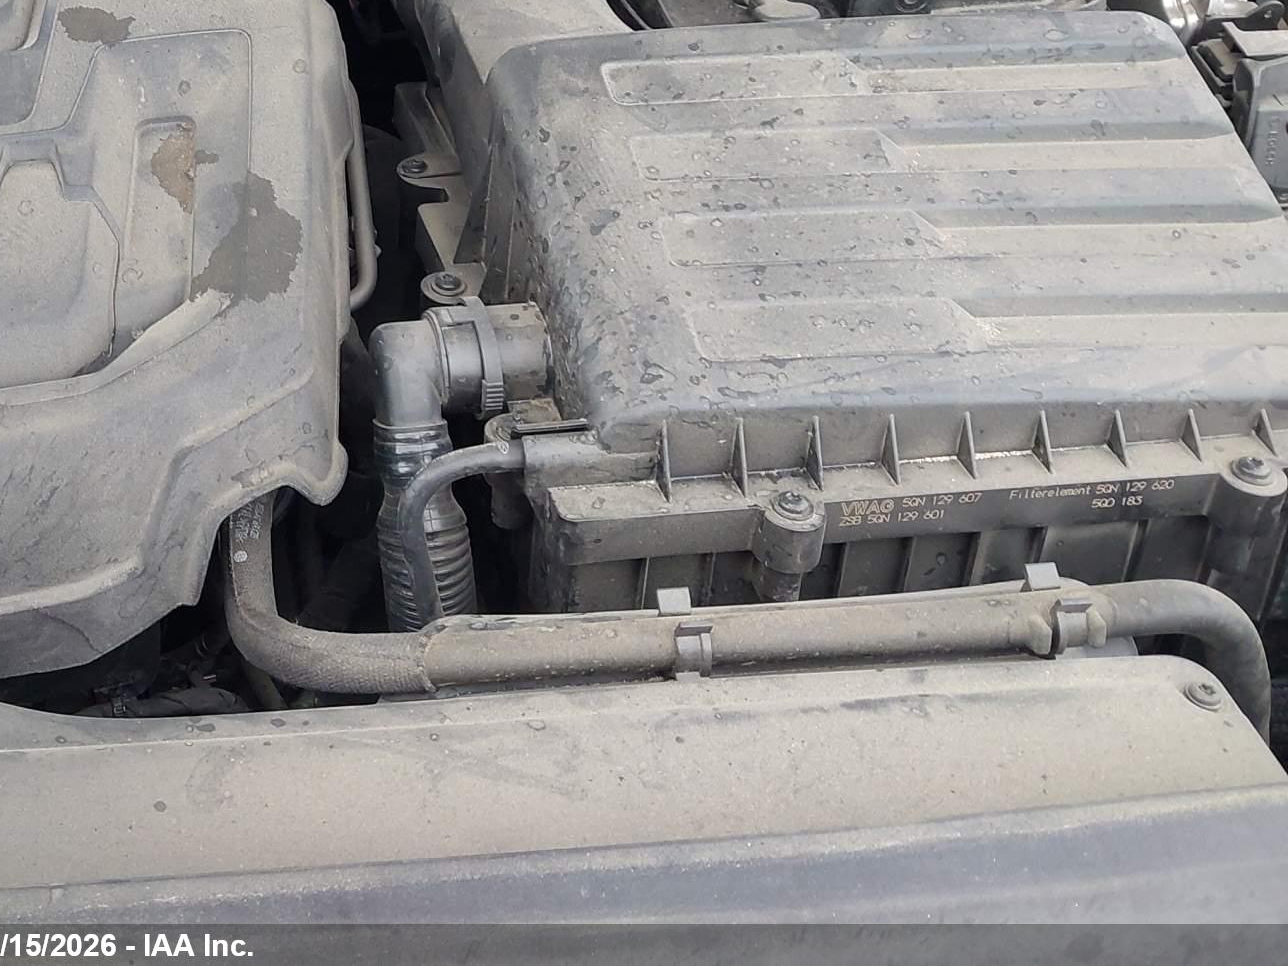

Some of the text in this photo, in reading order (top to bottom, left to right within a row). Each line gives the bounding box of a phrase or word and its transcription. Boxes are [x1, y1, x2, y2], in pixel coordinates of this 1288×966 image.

[1008, 485, 1091, 500] Filterelement
[1126, 481, 1147, 492] 129
[1151, 479, 1175, 490] 620
[841, 492, 983, 516] VWAG 5QN 129 607
[867, 514, 891, 524] 5QN
[898, 512, 919, 522] 129
[923, 509, 944, 520] 601
